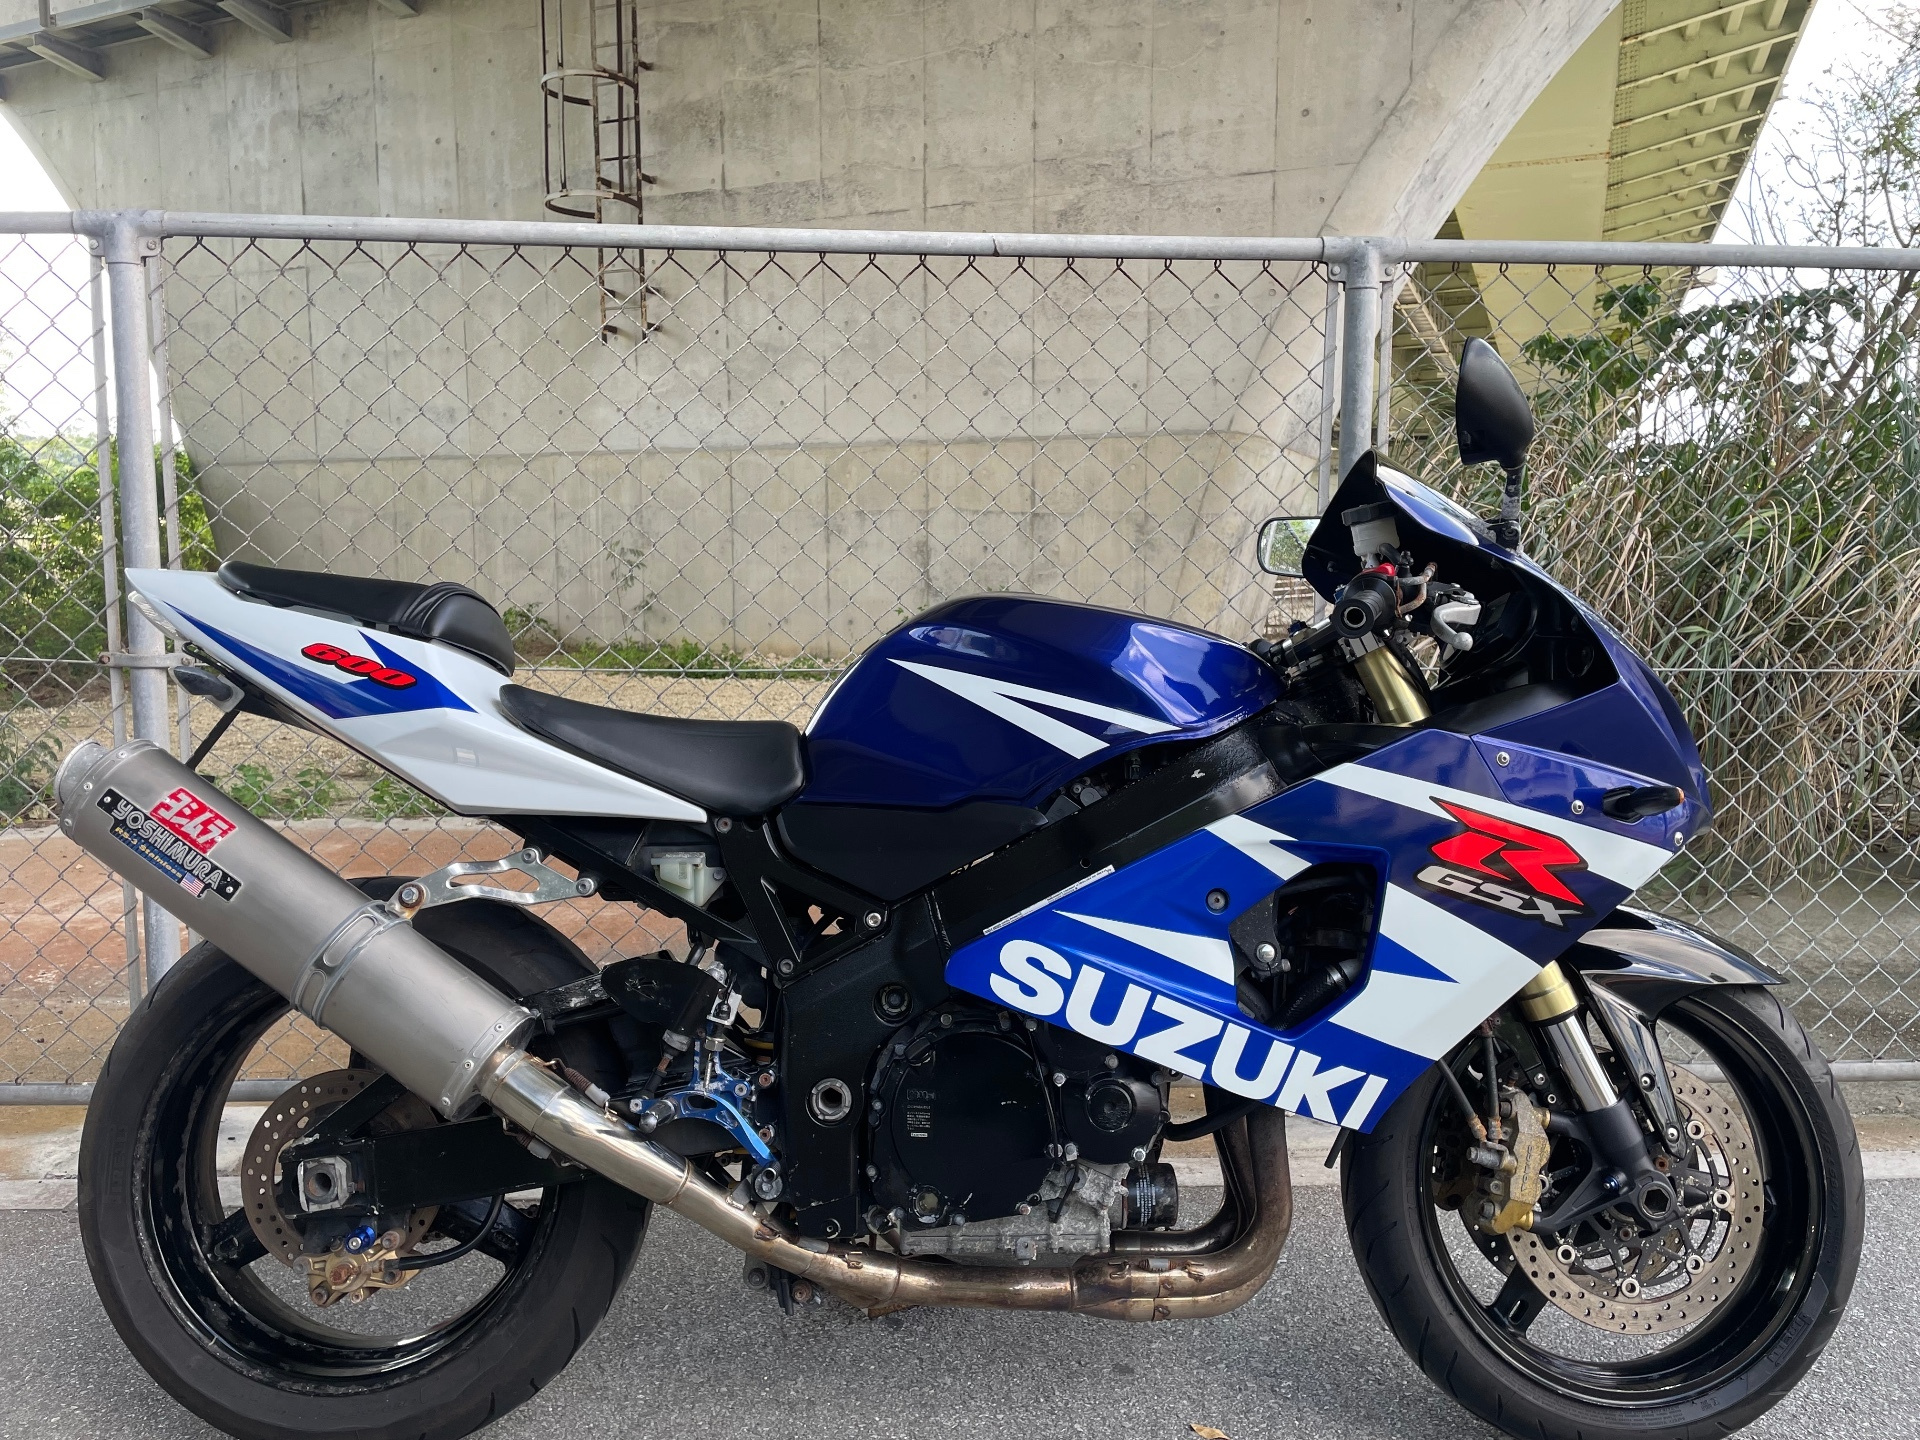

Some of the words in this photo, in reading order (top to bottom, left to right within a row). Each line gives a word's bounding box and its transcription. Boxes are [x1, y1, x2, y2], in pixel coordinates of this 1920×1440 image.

[301, 643, 417, 690] 600
[111, 799, 223, 890] YOSHIMURA
[157, 791, 230, 844] ヨシムラ
[114, 826, 138, 846] RS-3
[138, 844, 183, 879] Stainless
[1416, 865, 1583, 926] GSX
[989, 940, 1389, 1131] SUZUKI
